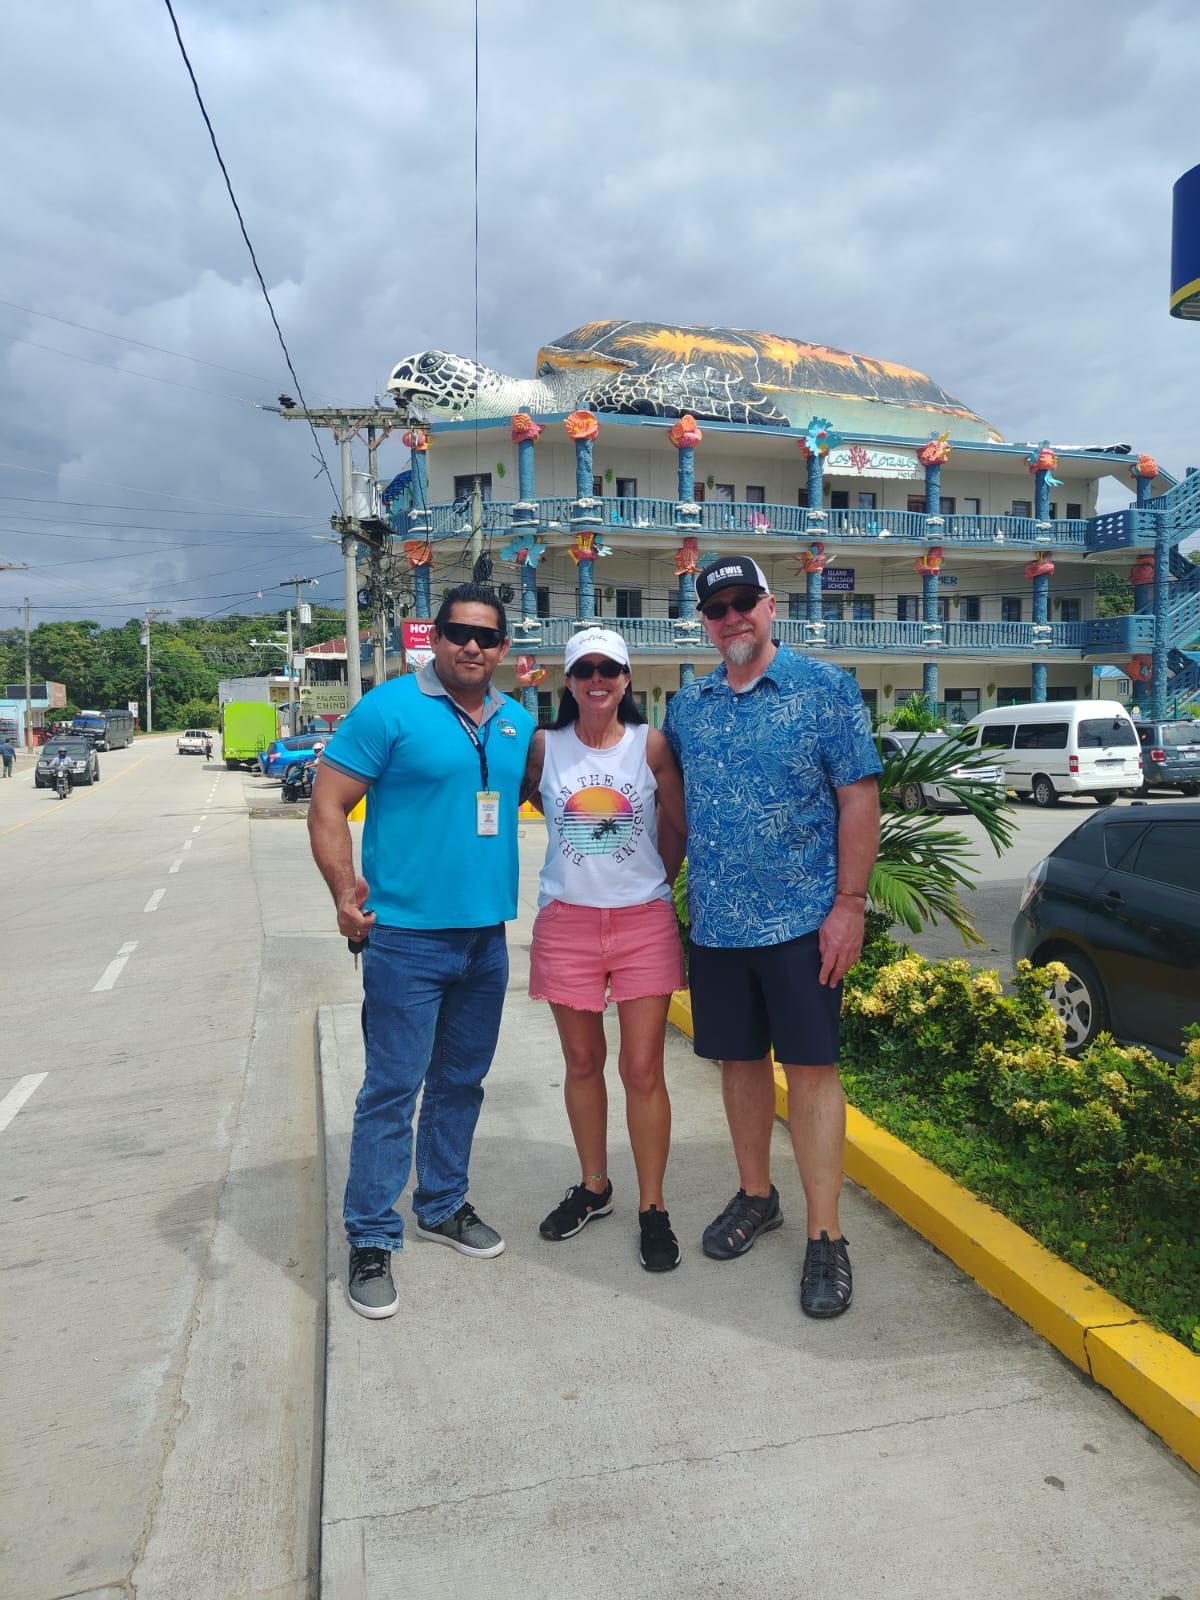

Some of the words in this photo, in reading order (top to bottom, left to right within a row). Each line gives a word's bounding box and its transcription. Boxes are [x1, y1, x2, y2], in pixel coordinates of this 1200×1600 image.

[715, 565, 743, 578] LEWIS
[316, 702, 346, 710] CHINO
[577, 774, 614, 788] THE
[555, 785, 573, 808] ON
[612, 782, 644, 864] SUNSHINE
[554, 816, 585, 867] BRING
